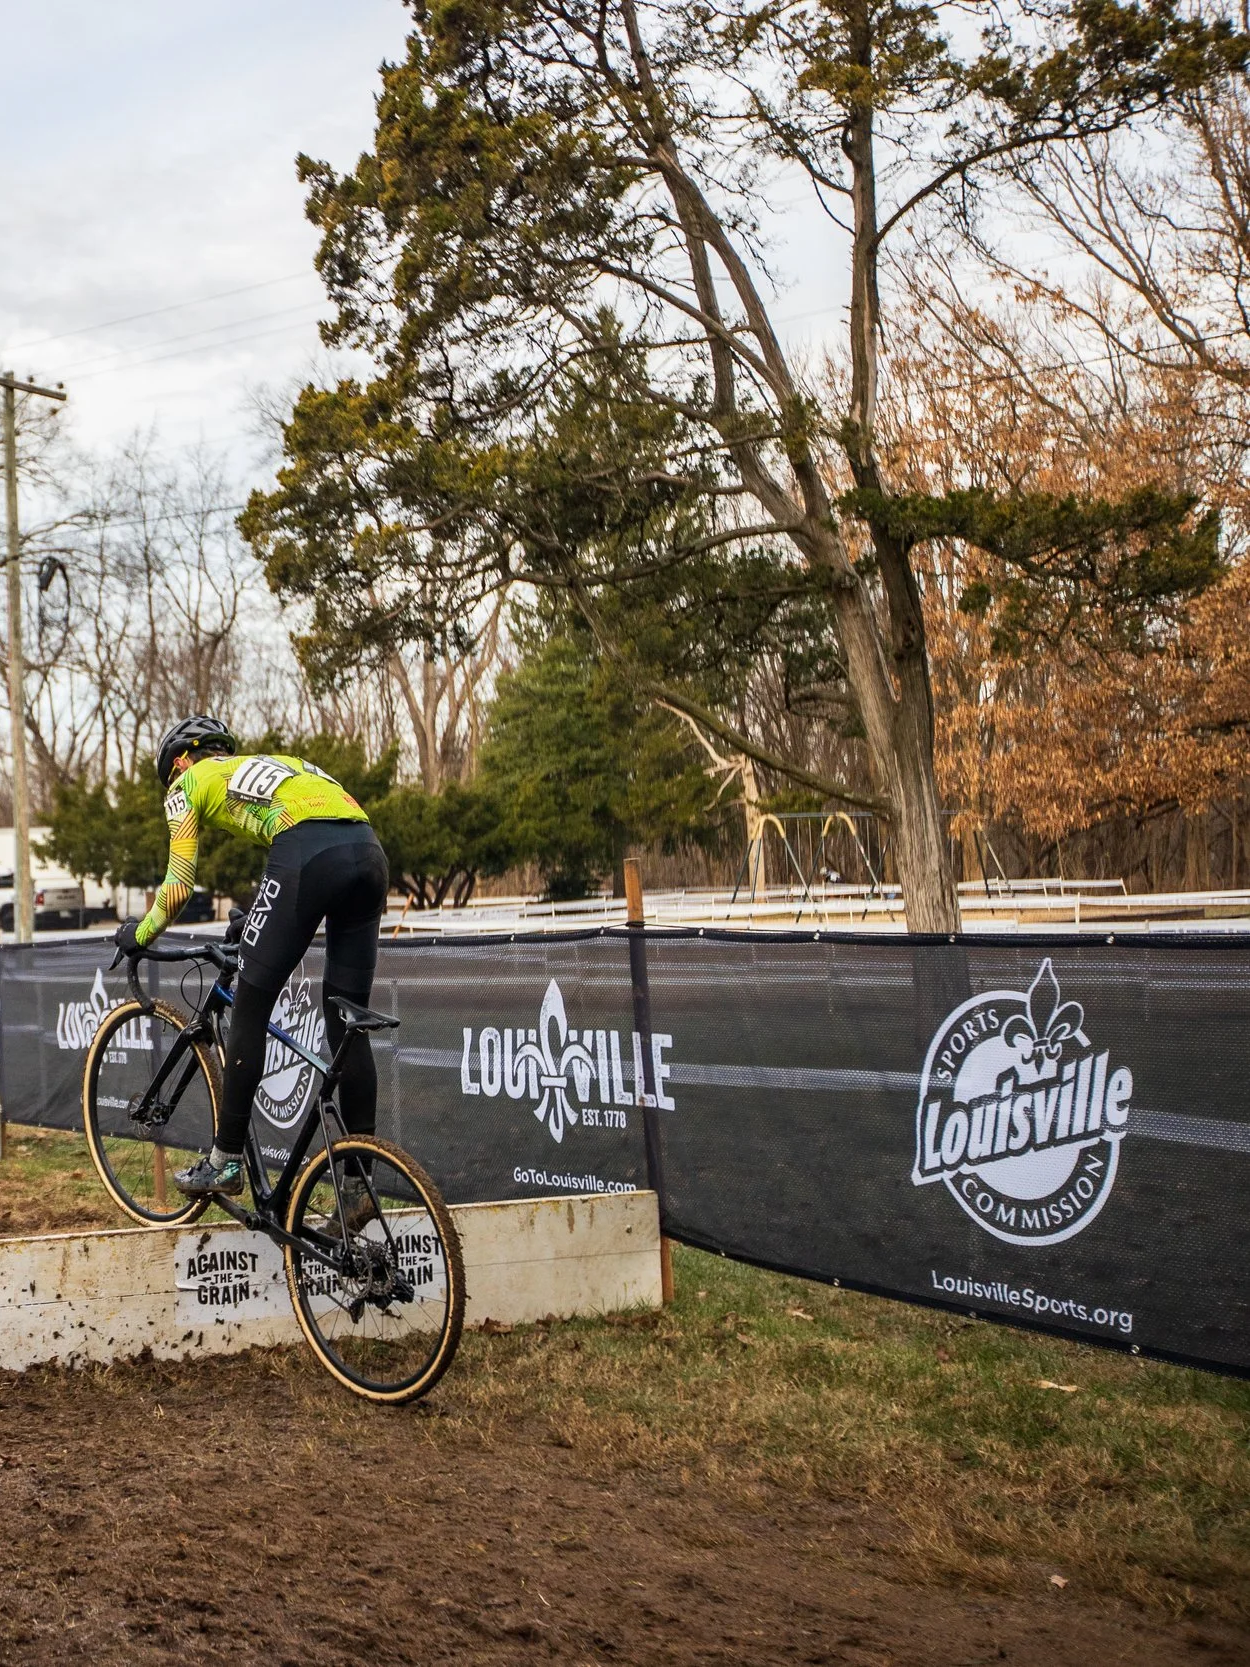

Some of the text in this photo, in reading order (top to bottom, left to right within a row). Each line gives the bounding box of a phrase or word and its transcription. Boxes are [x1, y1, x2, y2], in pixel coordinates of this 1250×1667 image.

[237, 761, 285, 796] 115
[167, 794, 186, 816] 115
[244, 879, 281, 946] DEVO
[938, 1008, 1000, 1083] SPORTS
[258, 1070, 310, 1119] COMMISSION
[582, 1108, 627, 1129] EST. 1778
[922, 1048, 1134, 1171] Louisville
[513, 1166, 637, 1193] GoToLouisville.com
[961, 1153, 1105, 1230] COMMISSION
[396, 1234, 441, 1256] AINST
[187, 1250, 259, 1280] AGAINST
[308, 1264, 327, 1275] THE
[400, 1256, 418, 1266] THE
[213, 1272, 233, 1284] THE
[197, 1281, 251, 1306] GRAIN
[931, 1269, 1134, 1334] LouisvilleSports.org
